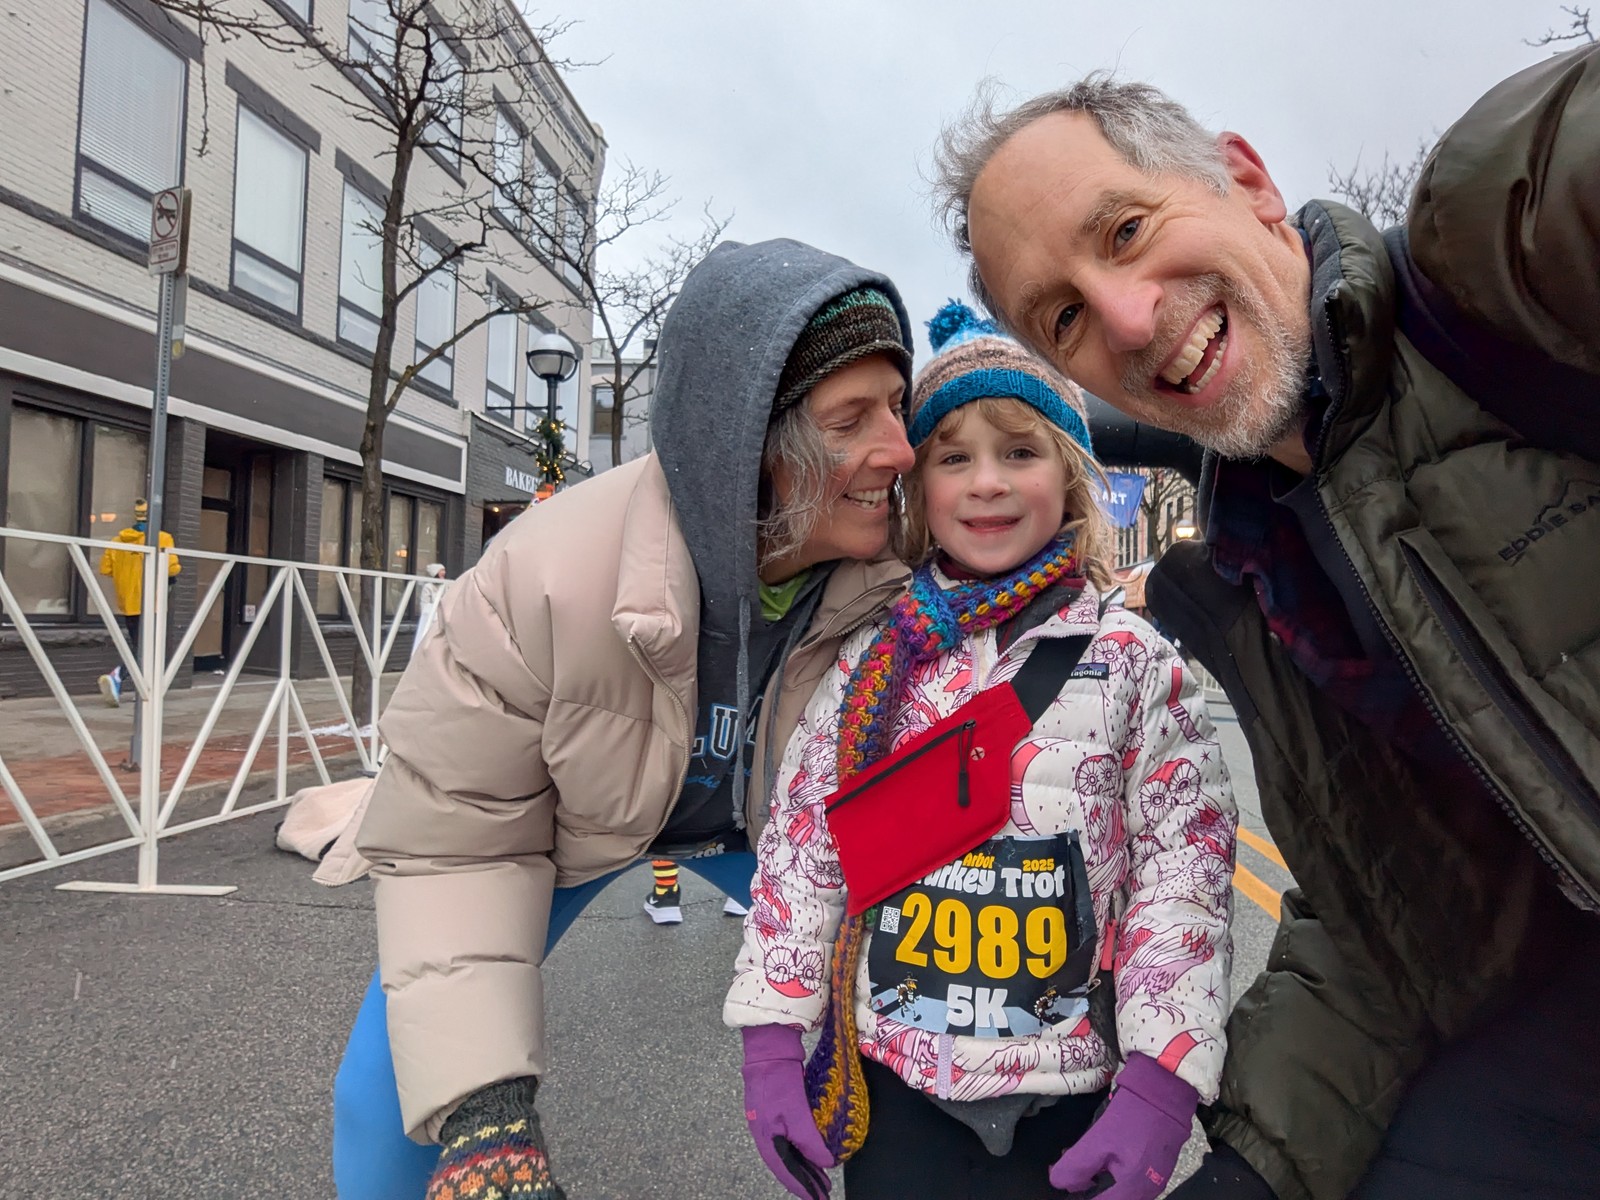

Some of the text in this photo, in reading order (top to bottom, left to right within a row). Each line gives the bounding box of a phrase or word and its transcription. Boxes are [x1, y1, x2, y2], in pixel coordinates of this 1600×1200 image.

[1498, 514, 1568, 561] EDDIE
[685, 842, 726, 859] rot
[962, 852, 995, 869] Arbor
[1022, 858, 1055, 872] 2025
[915, 860, 1065, 898] urkey Trot
[895, 892, 1067, 979] 2989
[945, 983, 1009, 1029] 5K
